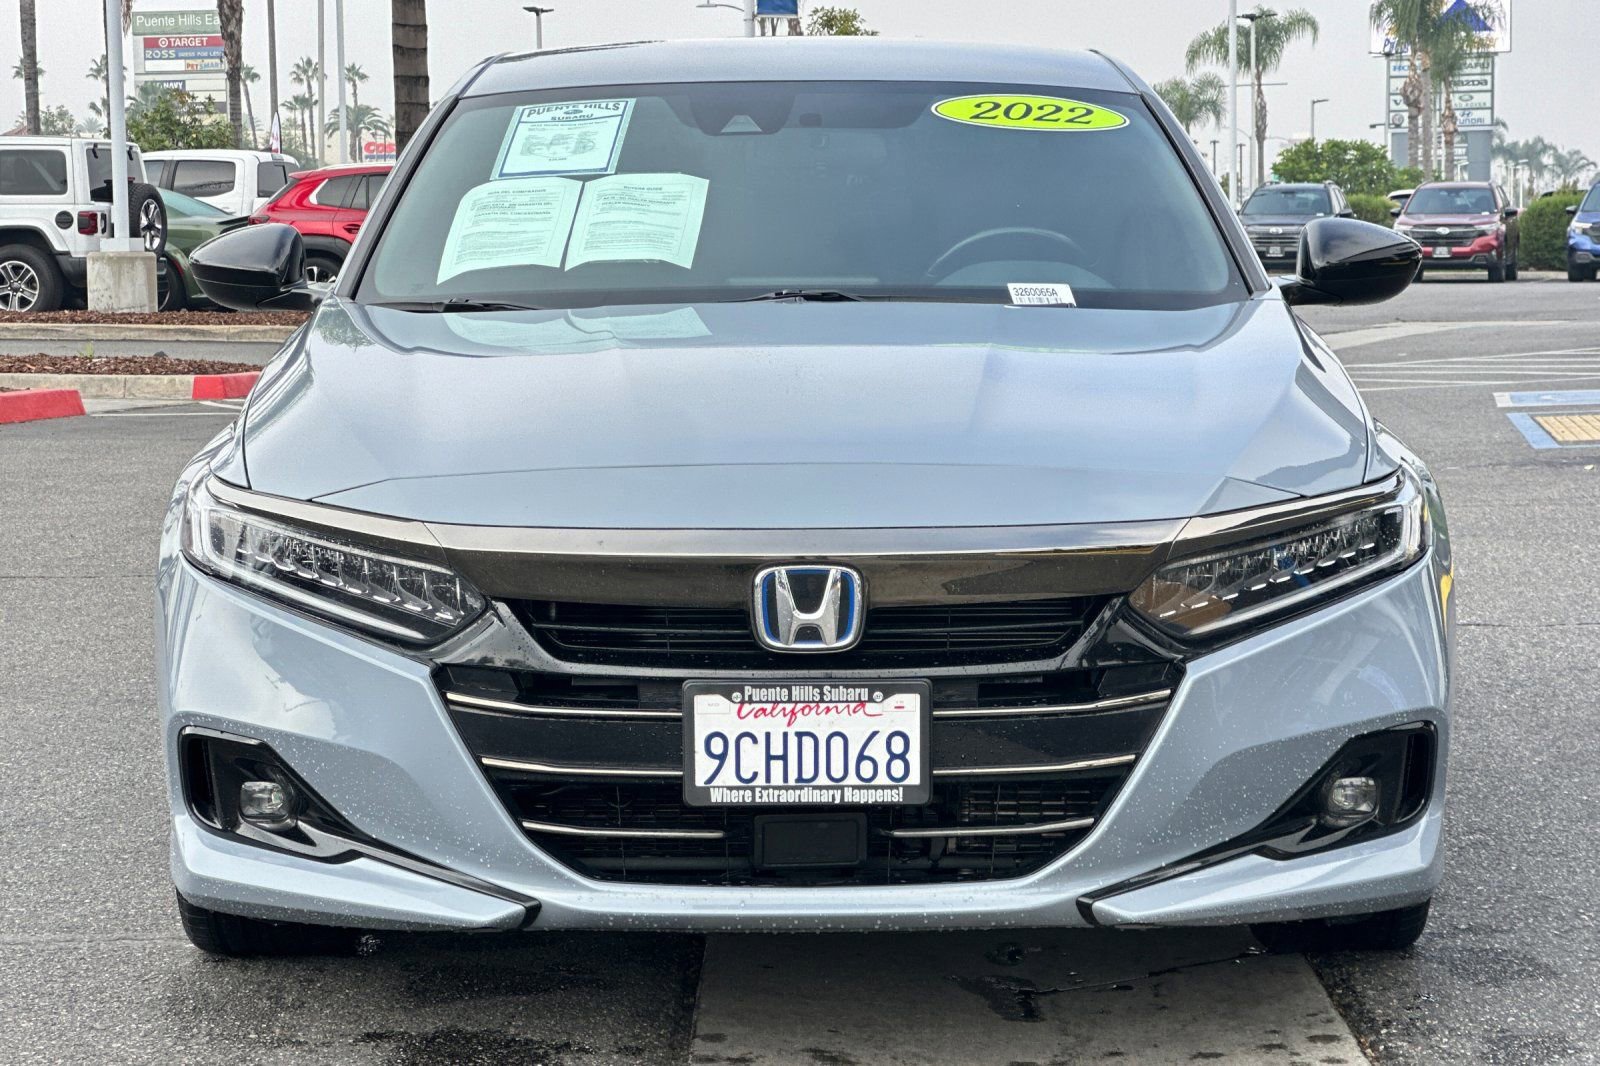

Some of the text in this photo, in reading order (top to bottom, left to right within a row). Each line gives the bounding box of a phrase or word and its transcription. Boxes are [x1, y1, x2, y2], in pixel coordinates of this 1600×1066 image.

[136, 13, 220, 27] Puente Hills Ea
[169, 37, 208, 47] TARGET
[145, 50, 176, 59] ROSS
[163, 81, 183, 90] NAVY
[526, 102, 621, 118] PUENTE HILLS
[551, 113, 594, 121] SUBARU
[969, 101, 1094, 125] 2022
[1012, 287, 1058, 297] 3260065A
[744, 685, 869, 701] Puente Hills Subaru
[737, 702, 884, 728] California
[703, 730, 911, 785] 9CHD068
[710, 786, 904, 804] Where Extraordinary Happens!
